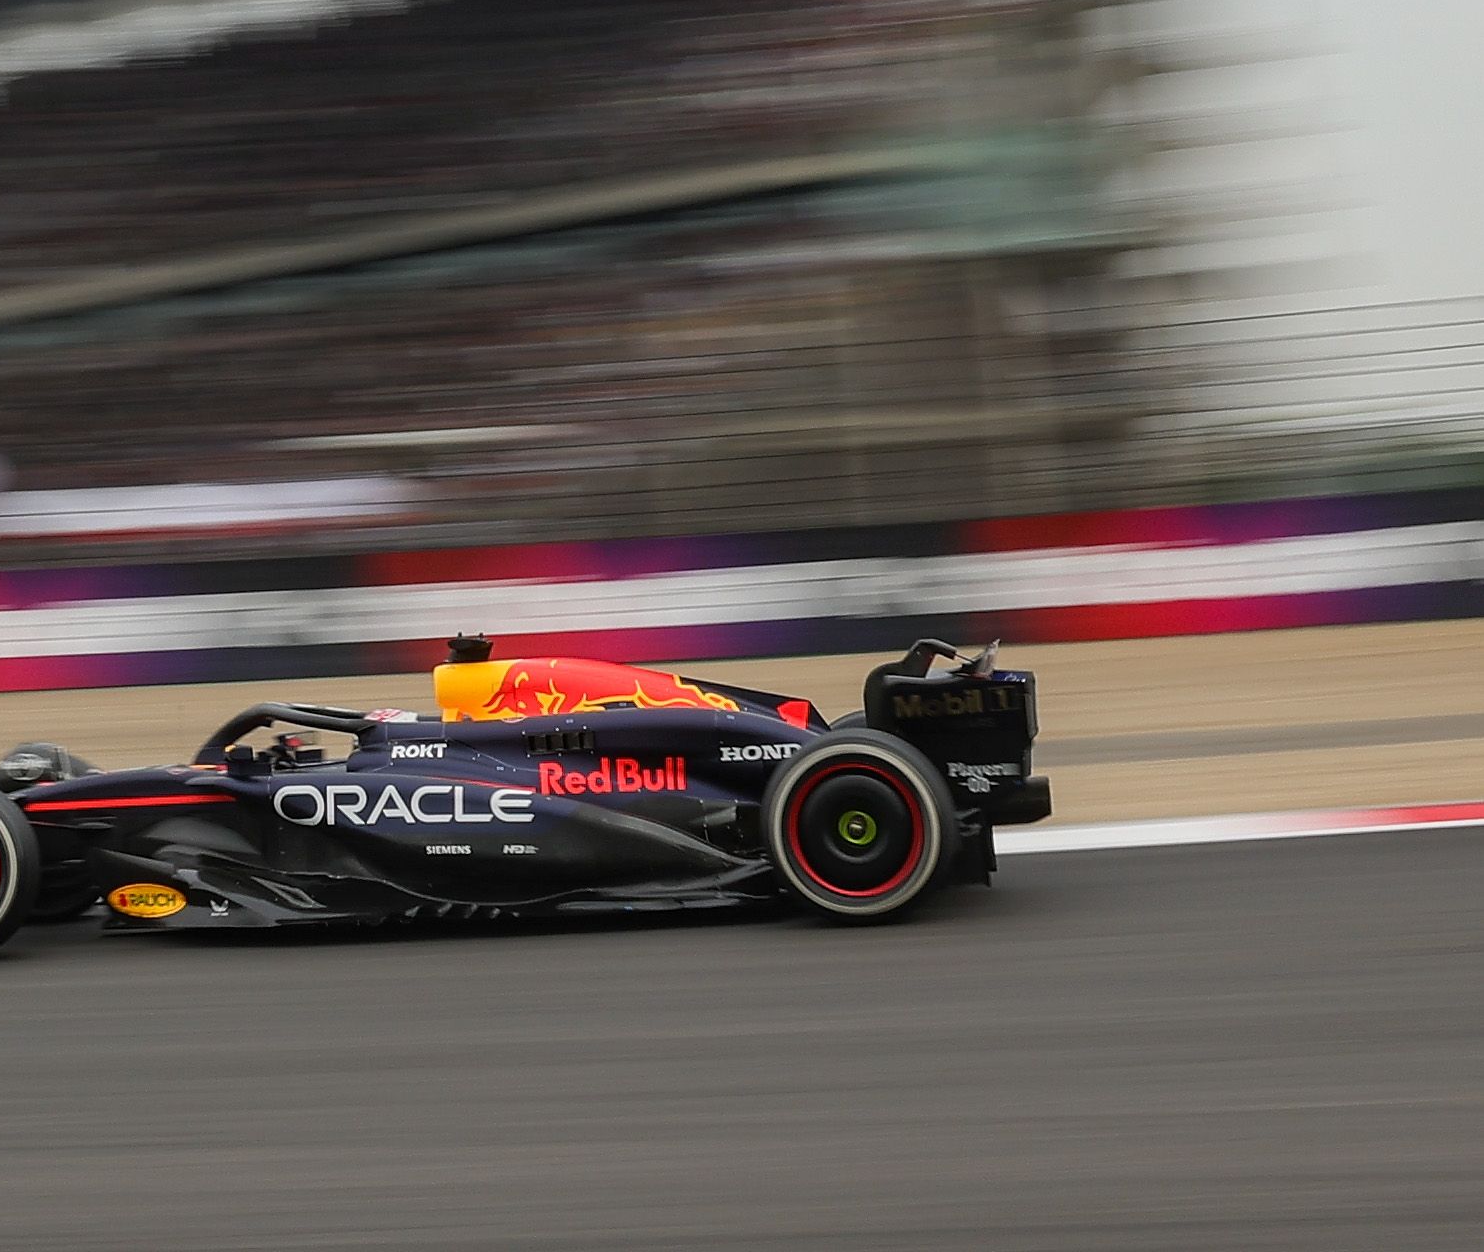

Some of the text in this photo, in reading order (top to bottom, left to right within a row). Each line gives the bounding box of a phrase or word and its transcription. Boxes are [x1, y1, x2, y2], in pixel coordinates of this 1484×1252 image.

[391, 742, 448, 759] ROKT
[719, 742, 802, 762] HOND
[539, 756, 686, 796] Red Bull
[273, 784, 536, 826] ORACLE
[426, 845, 472, 855] SIEMENS
[129, 893, 176, 906] RAUCH
